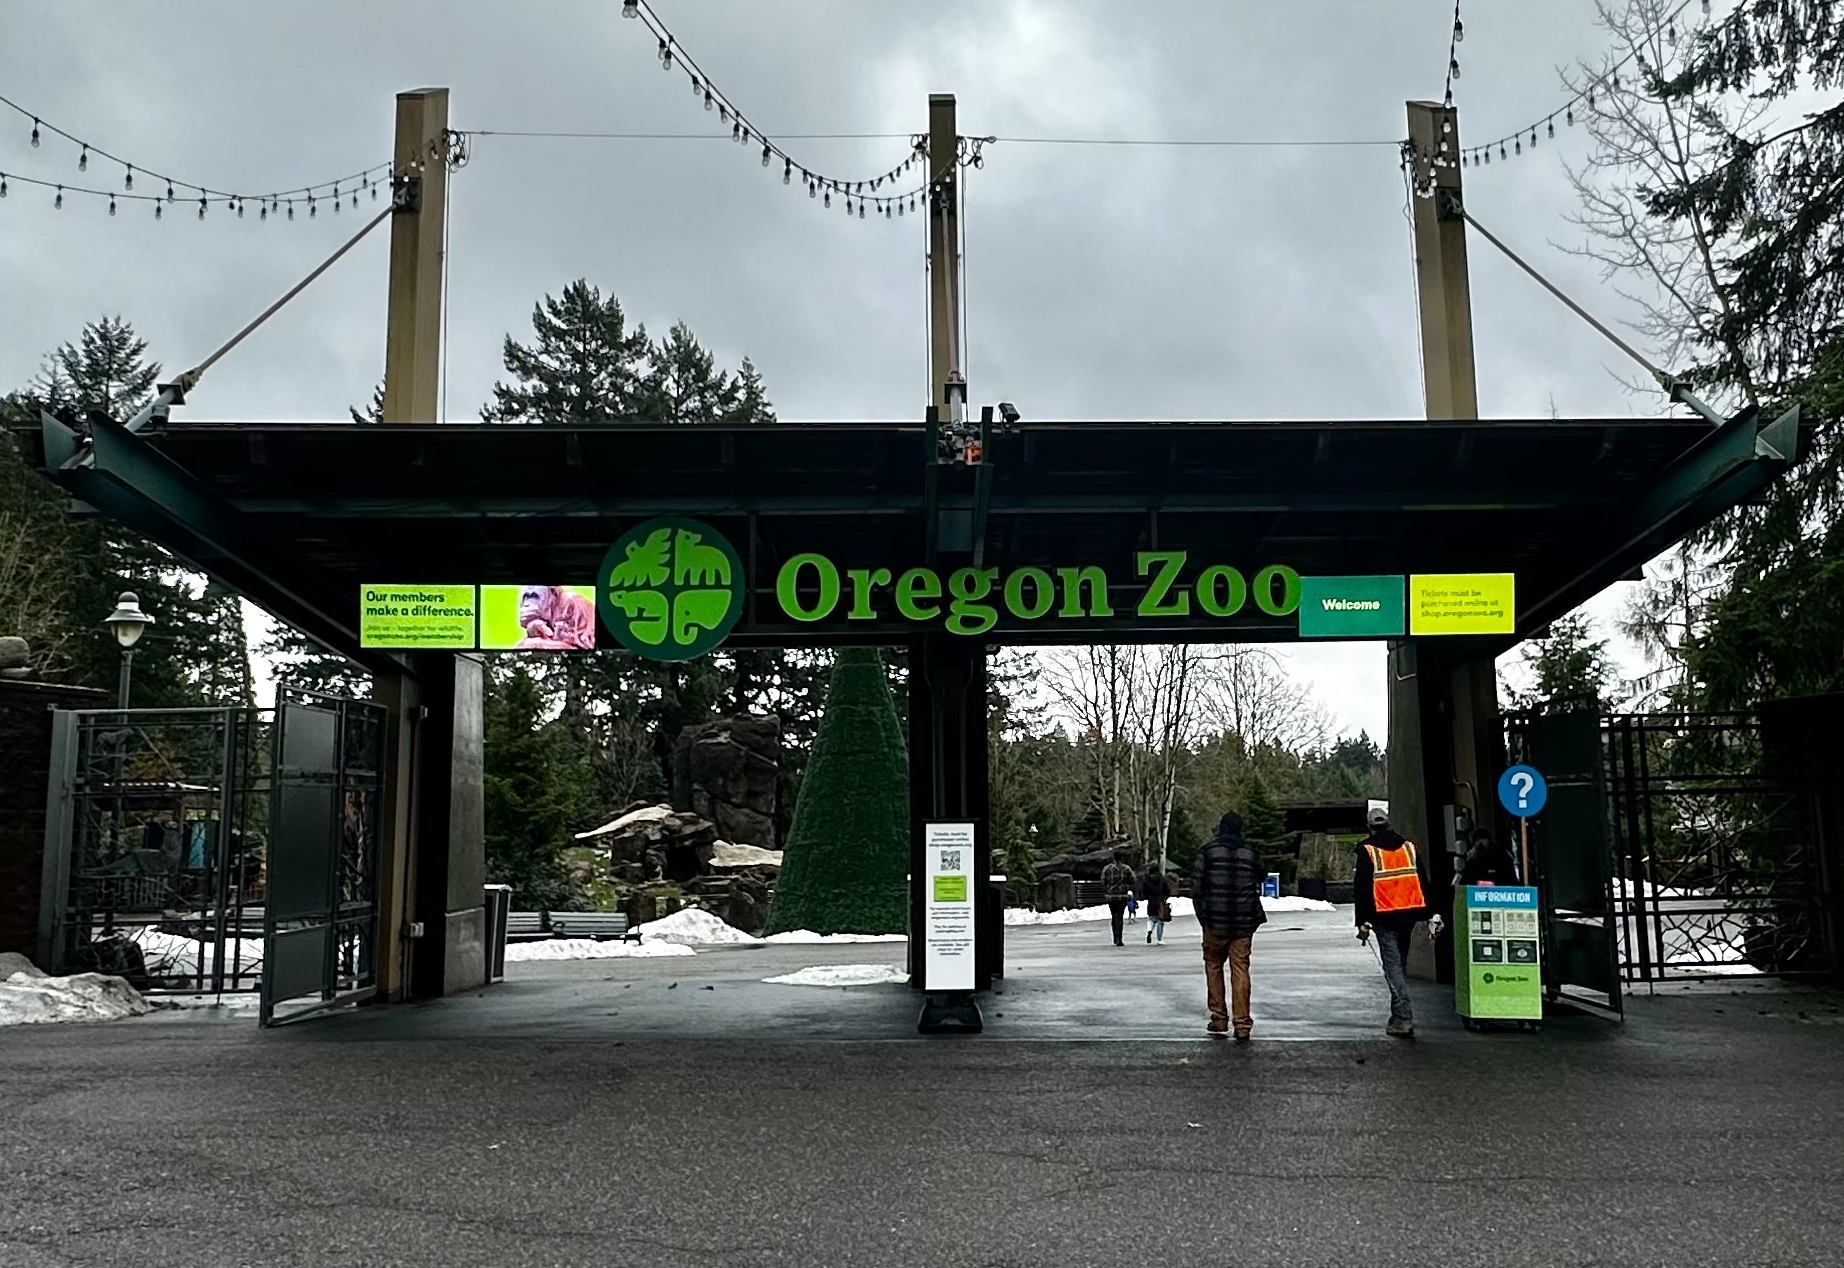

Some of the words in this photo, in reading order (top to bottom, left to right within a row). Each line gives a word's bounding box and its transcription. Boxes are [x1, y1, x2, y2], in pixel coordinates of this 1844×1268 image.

[366, 590, 388, 602] Our
[390, 591, 445, 603] members
[775, 552, 1114, 635] Oregon
[1137, 550, 1300, 617] Zoo
[1420, 589, 1448, 597] Tickets
[1450, 589, 1469, 597] must
[1471, 589, 1482, 597] be
[366, 604, 398, 616] make
[400, 608, 409, 616] a
[411, 604, 474, 617] difference.
[1321, 598, 1381, 611] Welcome
[1474, 891, 1531, 903] INFORMATION
